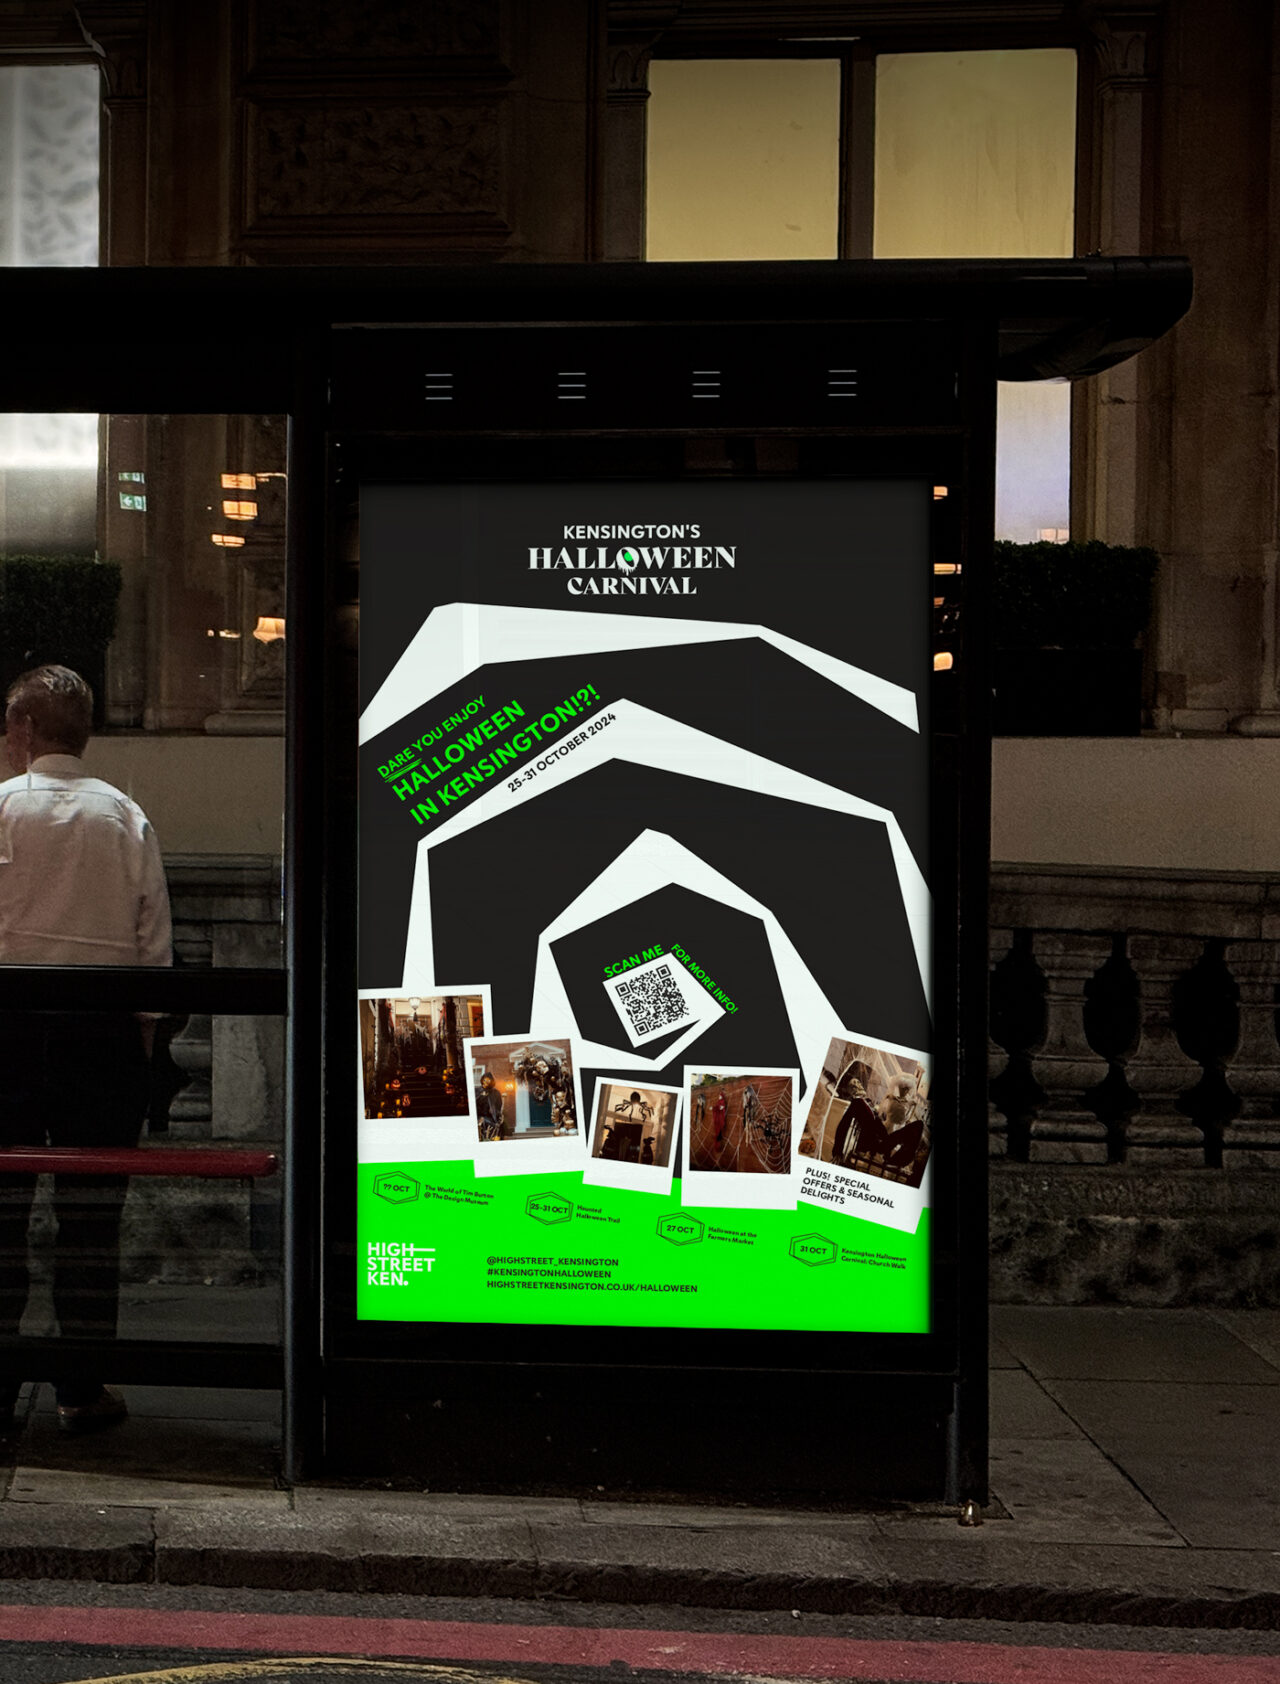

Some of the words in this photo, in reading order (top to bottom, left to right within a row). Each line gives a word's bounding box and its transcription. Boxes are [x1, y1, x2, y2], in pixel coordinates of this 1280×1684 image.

[563, 524, 701, 540] KENSINGTON'S
[528, 546, 737, 572] HALLOWEEN
[567, 576, 697, 595] CARNIVAL
[377, 747, 415, 778] DARE
[412, 726, 443, 752] YOU
[441, 695, 486, 732] ENJOY
[392, 700, 526, 801] HALLOWEEN
[409, 797, 440, 825] IN
[436, 684, 600, 806] KENSINGTON!?!
[507, 767, 538, 793] 25-31
[536, 731, 590, 772] OCTOBER
[587, 712, 617, 736] 2024
[604, 954, 641, 978] SCAN
[642, 944, 664, 962] ME
[671, 943, 692, 964] FOR
[688, 961, 717, 991] MORE
[712, 987, 739, 1014] INFO!
[806, 1167, 831, 1181] PLUS!
[834, 1175, 871, 1192] SPECIAL
[393, 1184, 410, 1193] OCT
[425, 1184, 436, 1192] The
[437, 1186, 454, 1194] World
[463, 1189, 474, 1197] Tim
[432, 1192, 443, 1200] The
[800, 1186, 845, 1205] DELIGHTS
[803, 1177, 837, 1193] OFFERS
[838, 1186, 845, 1195] &
[847, 1188, 895, 1209] SEASONAL
[531, 1203, 551, 1212] 25-31
[551, 1206, 569, 1214] OCT
[666, 1224, 676, 1232] 27
[676, 1226, 695, 1234] OCT
[368, 1242, 436, 1257] HIGH
[800, 1245, 808, 1253] 31
[809, 1246, 827, 1255] OCT
[367, 1257, 436, 1272] STREET
[486, 1256, 619, 1267] @HIGHSTREET_KENSINGTON
[368, 1271, 409, 1286] KEN.
[487, 1268, 612, 1279] #KENSINGTONHALLOWEEN
[486, 1280, 698, 1293] HIGHSTREETKENSINGTON.CO.UK/HALLOWEEN
